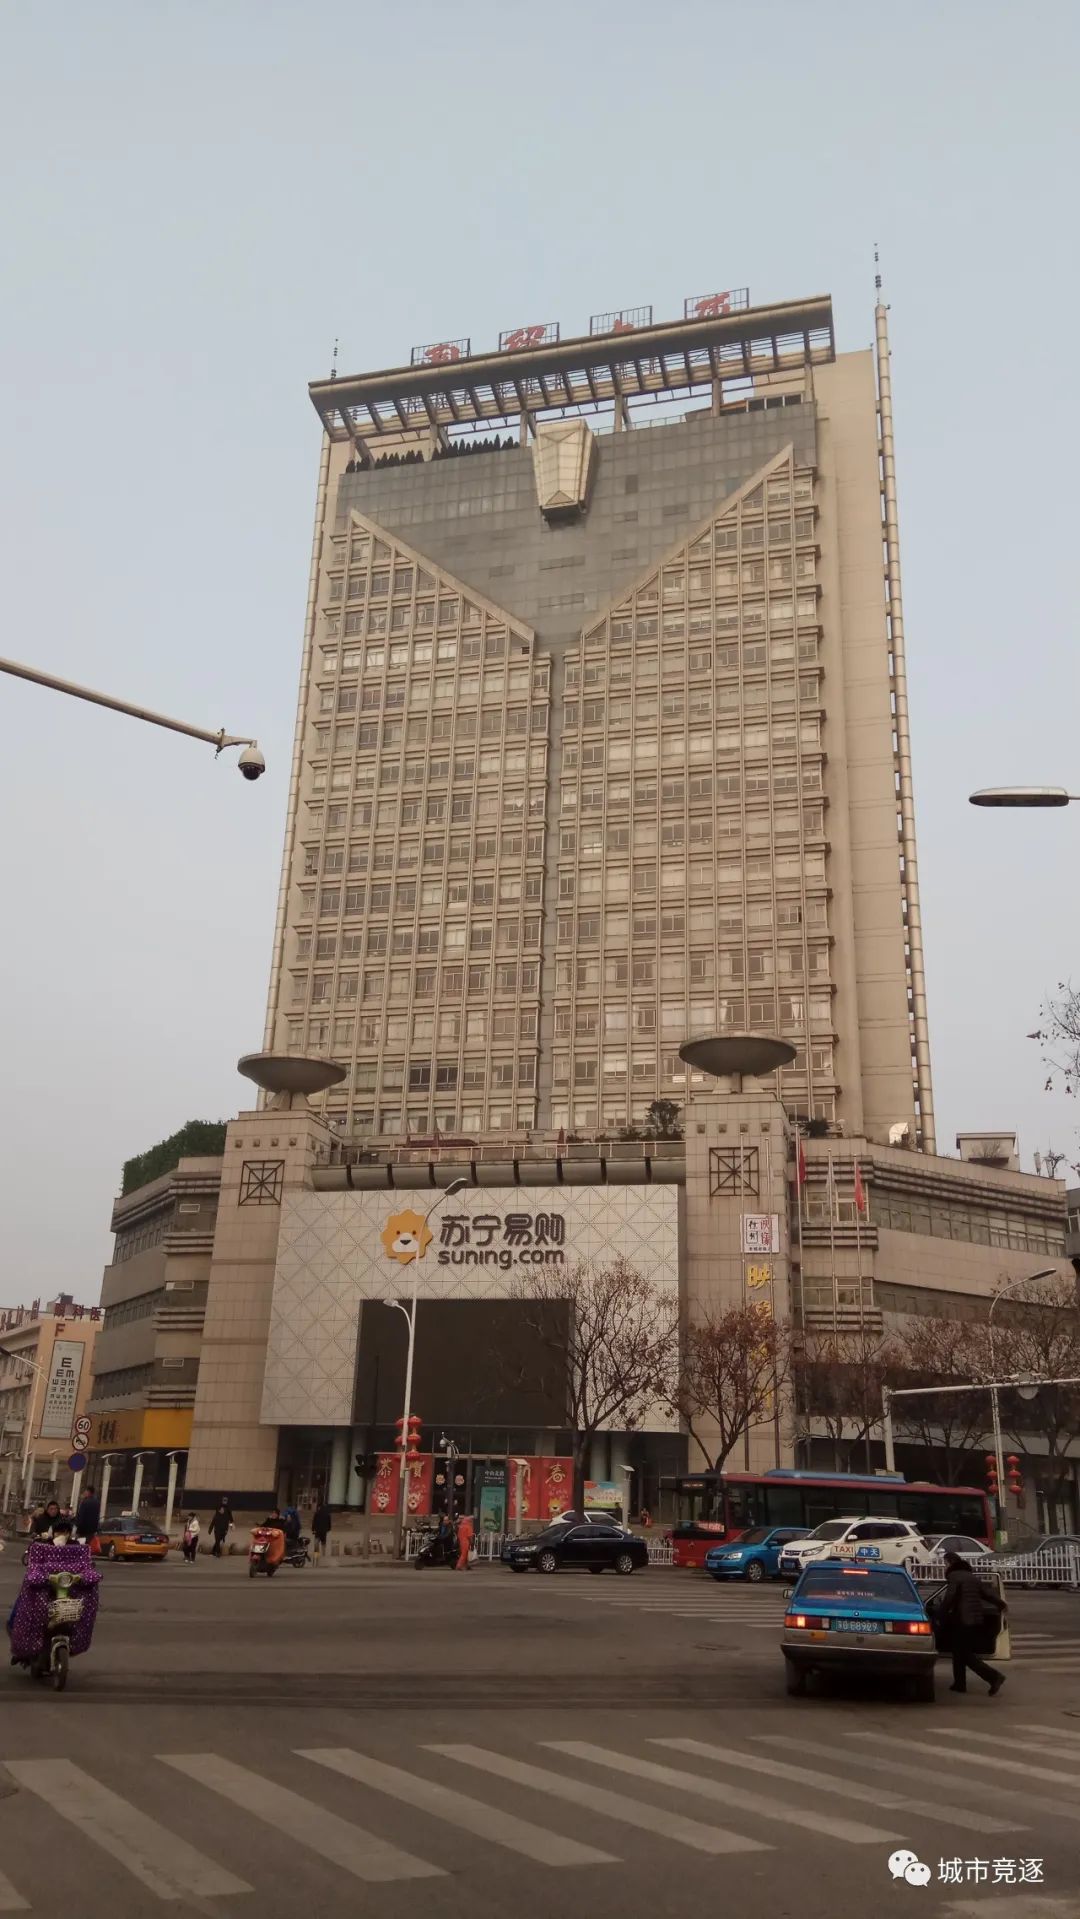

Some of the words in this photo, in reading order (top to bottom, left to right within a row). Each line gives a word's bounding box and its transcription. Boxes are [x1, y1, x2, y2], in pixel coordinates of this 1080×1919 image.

[439, 1213, 565, 1247] 苏宁易购
[437, 1249, 565, 1271] suning.com
[78, 1420, 90, 1431] 60
[834, 1545, 854, 1554] TAXI
